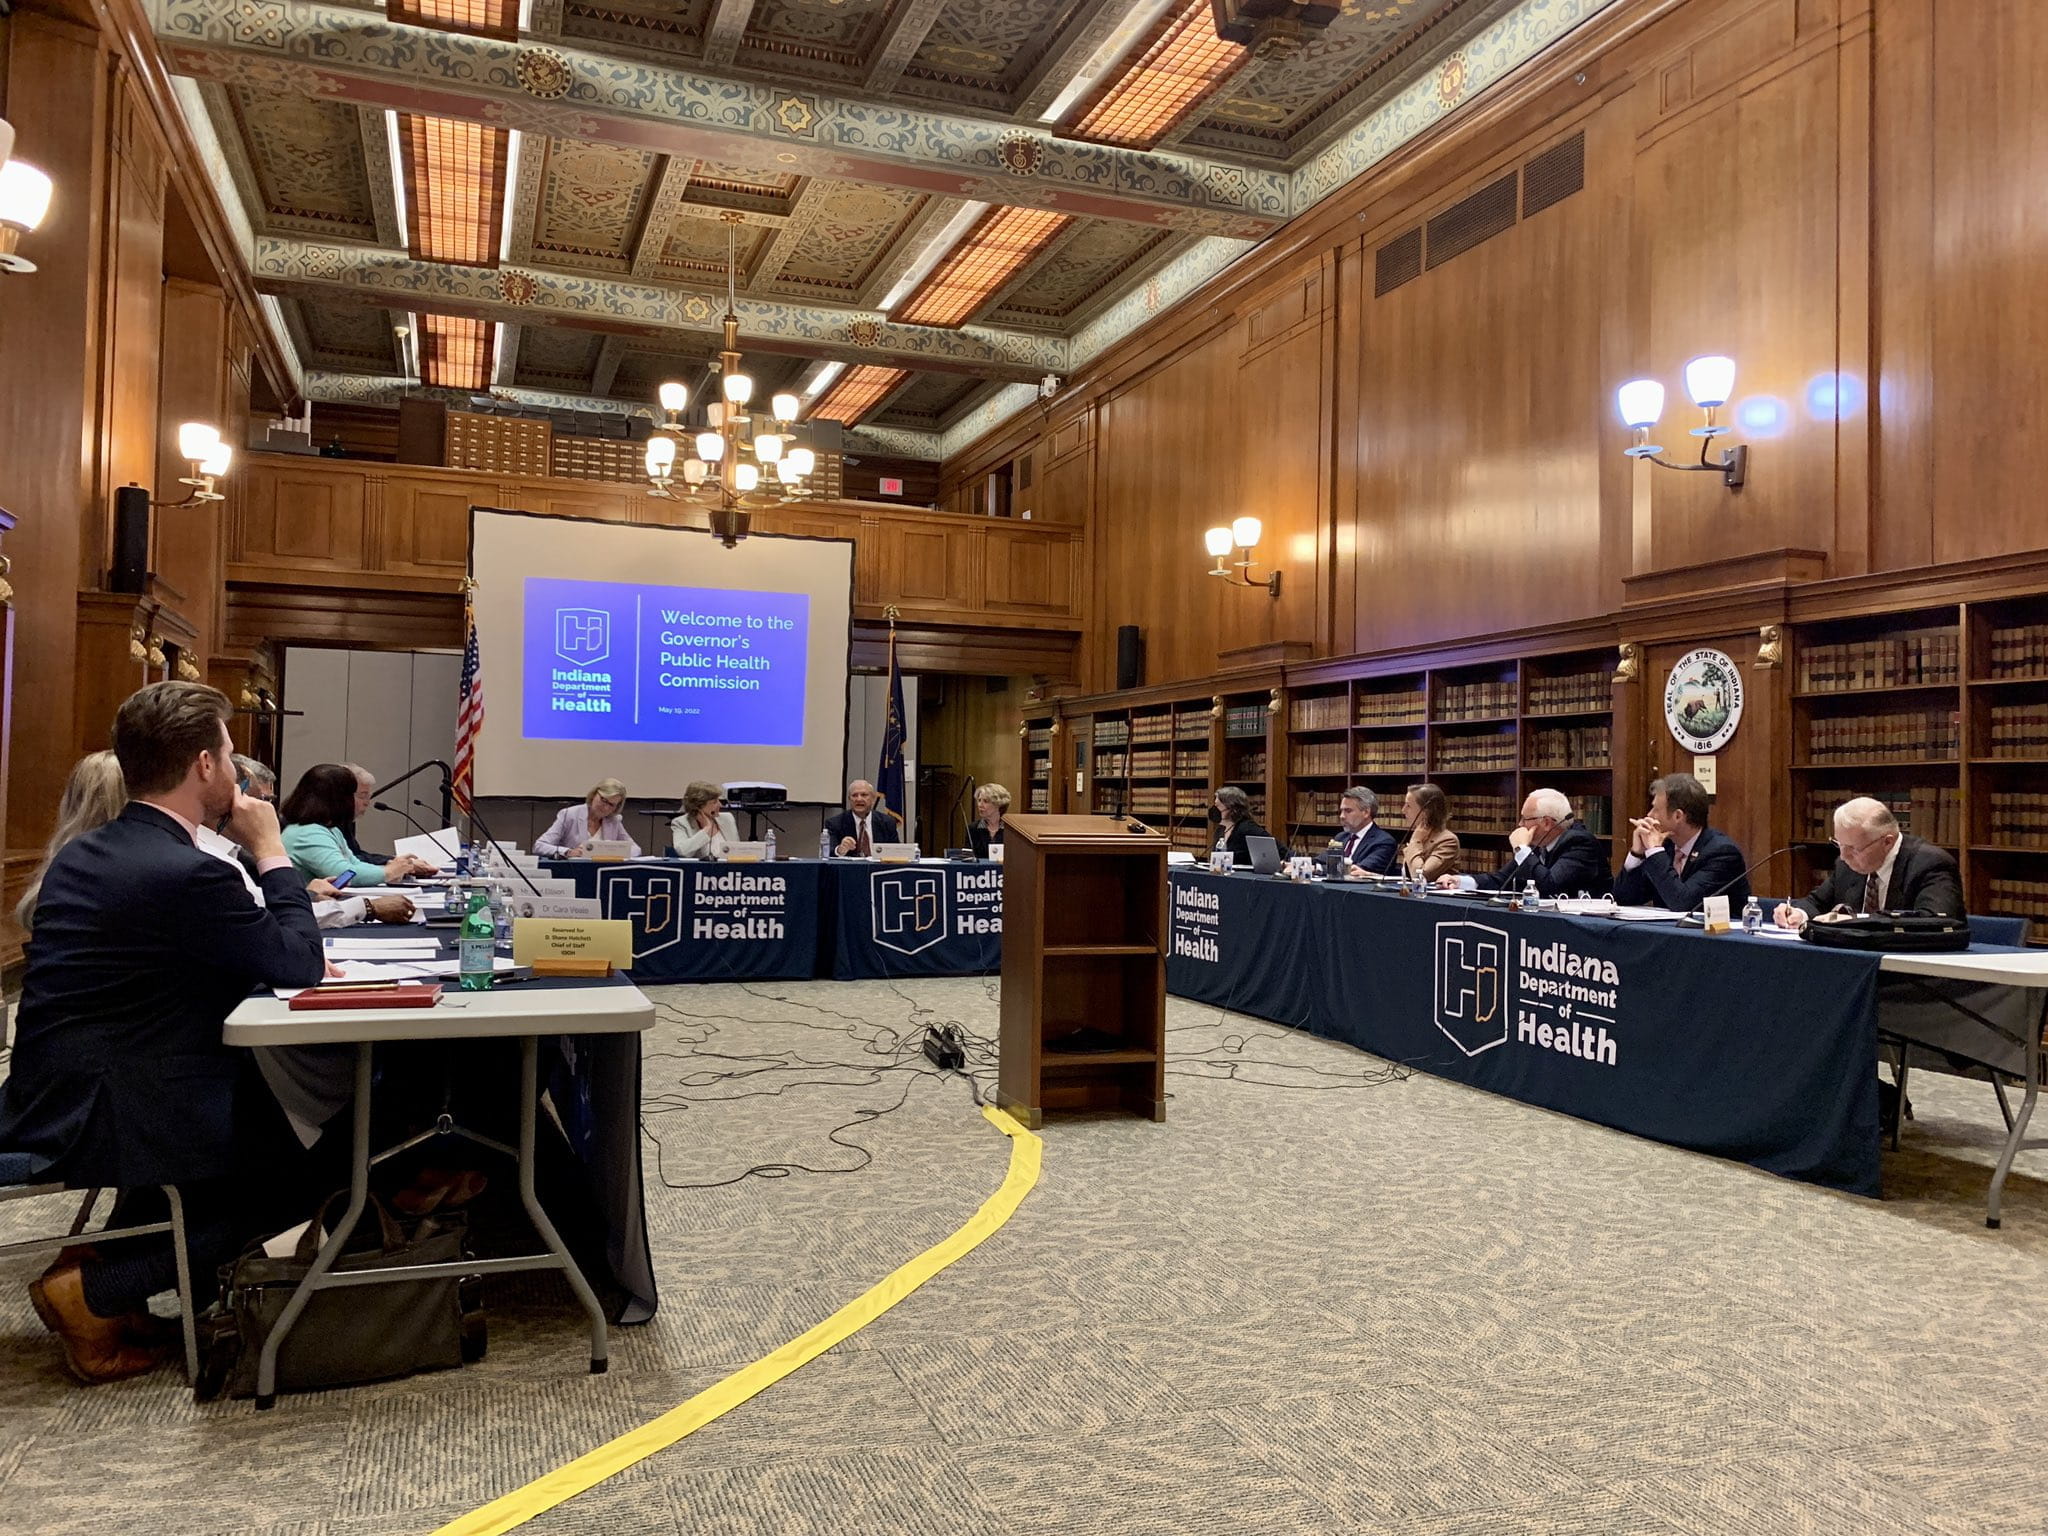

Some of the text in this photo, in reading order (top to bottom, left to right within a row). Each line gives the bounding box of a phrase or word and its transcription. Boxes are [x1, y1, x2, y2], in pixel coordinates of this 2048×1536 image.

[661, 609, 794, 630] Welcome to the
[660, 631, 750, 649] Governor's
[660, 651, 770, 670] Public Health
[552, 668, 612, 683] Indiana
[659, 672, 760, 690] Commission
[1679, 656, 1692, 671] THE
[1695, 651, 1718, 661] STATE
[1719, 658, 1729, 668] OF
[1728, 668, 1740, 709] INDIANA
[552, 681, 611, 692] Department
[577, 691, 587, 699] of
[552, 697, 612, 713] Health
[658, 706, 673, 715] May
[1694, 740, 1713, 750] 1816
[695, 871, 786, 892] Indiana
[956, 870, 1004, 890] Indi
[694, 893, 785, 908] Department
[956, 890, 1003, 905] Depart
[1176, 885, 1219, 910] Indiana
[733, 907, 748, 918] of
[1176, 907, 1219, 925] Department
[693, 918, 785, 940] Health
[957, 914, 1003, 935] Hea
[1193, 925, 1201, 936] of
[1175, 933, 1219, 963] Health
[1519, 938, 1620, 986] Indiana
[1519, 970, 1618, 1009] Department
[1558, 1003, 1573, 1020] of
[1518, 1010, 1618, 1067] Health
